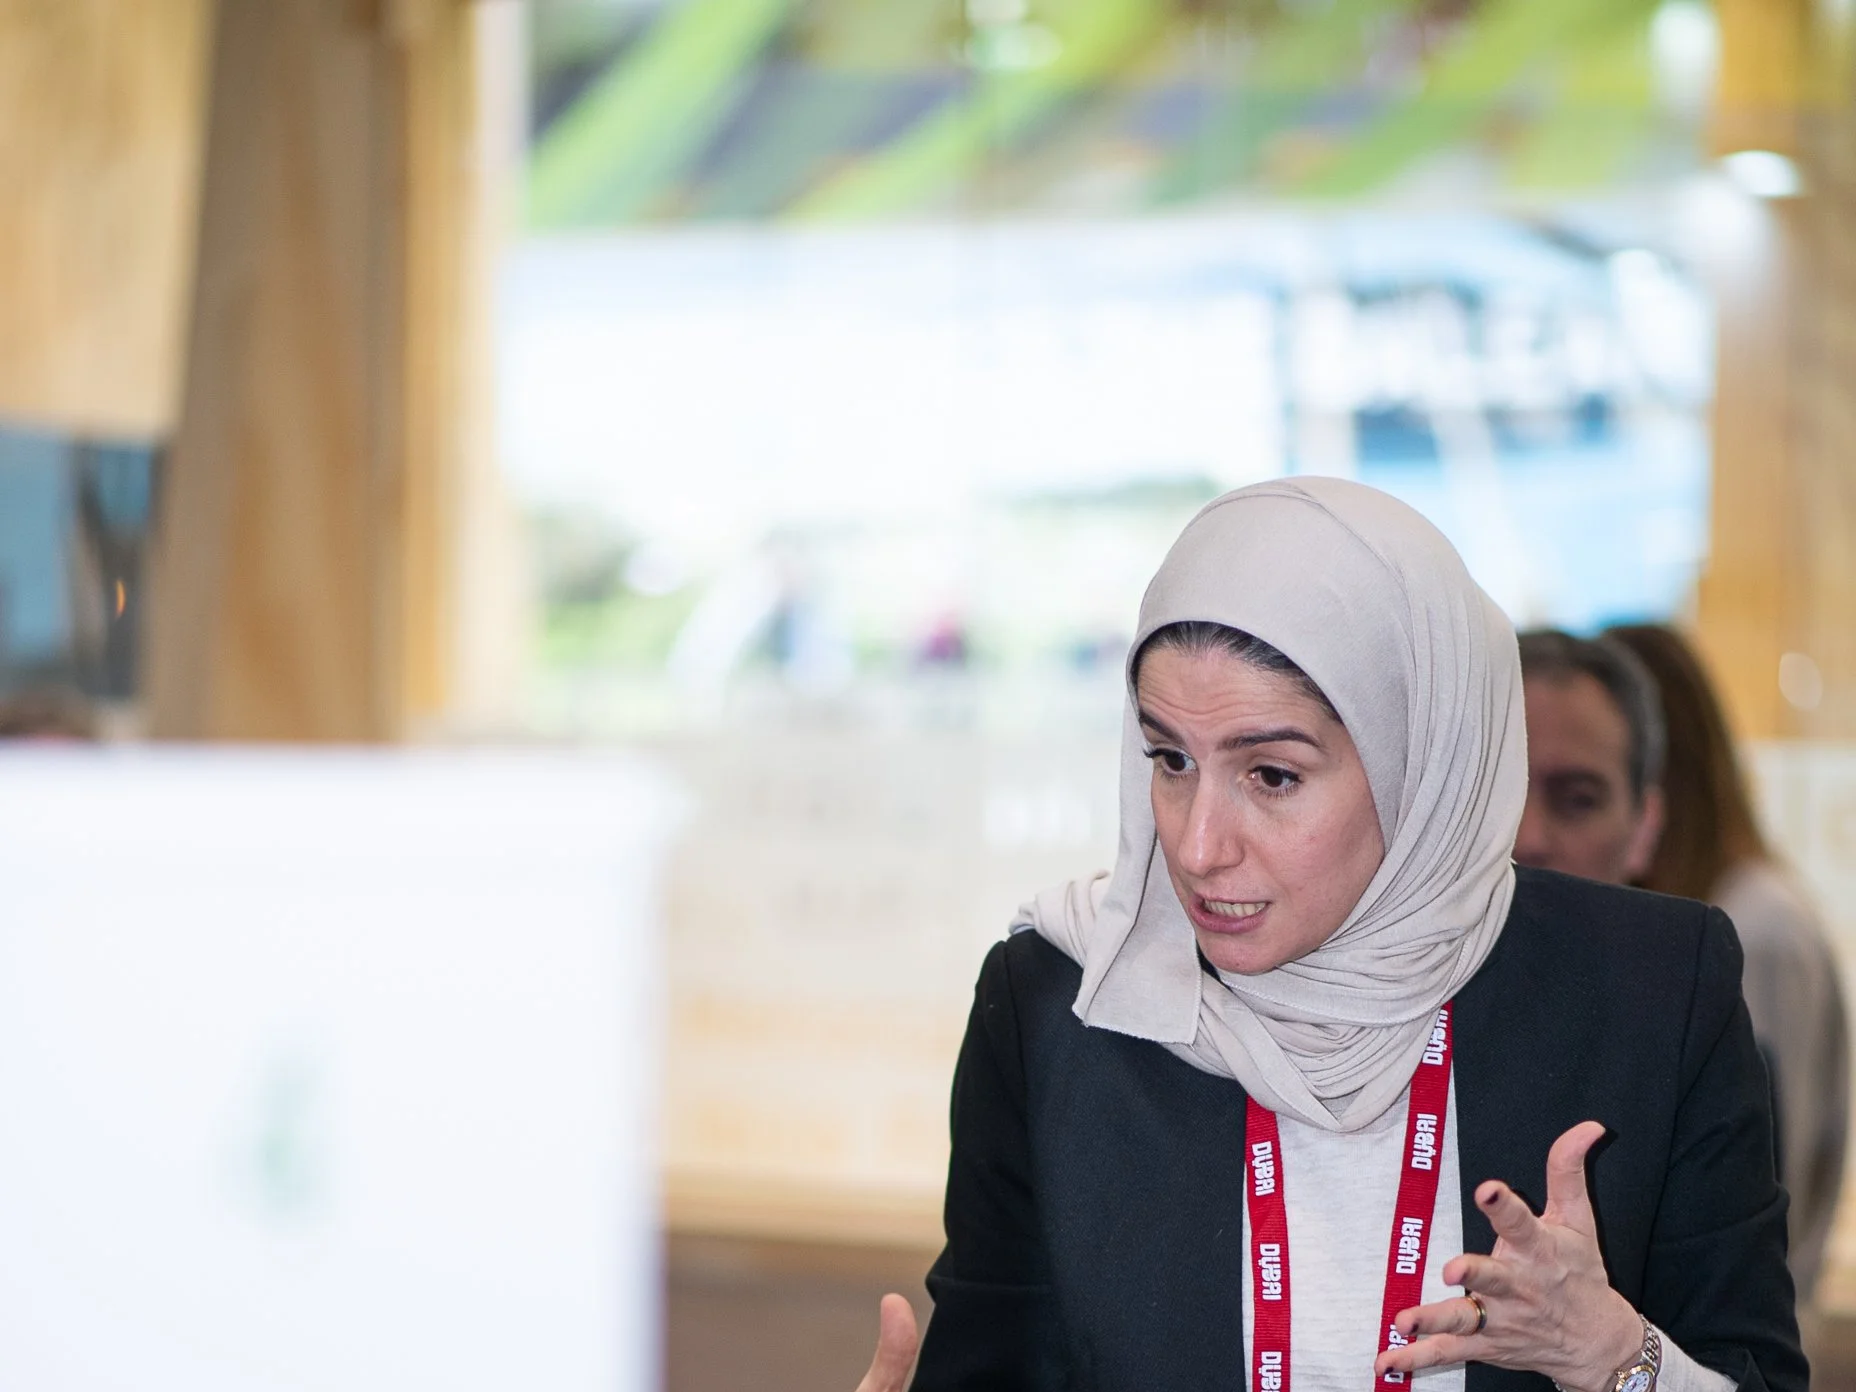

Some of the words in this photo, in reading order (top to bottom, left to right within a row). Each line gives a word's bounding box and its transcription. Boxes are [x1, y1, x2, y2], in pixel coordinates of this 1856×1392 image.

[1251, 1140, 1275, 1196] DUBAI
[1411, 1113, 1438, 1170] DUBAI
[1259, 1243, 1282, 1300] DUBAI
[1396, 1217, 1423, 1274] DUBAI
